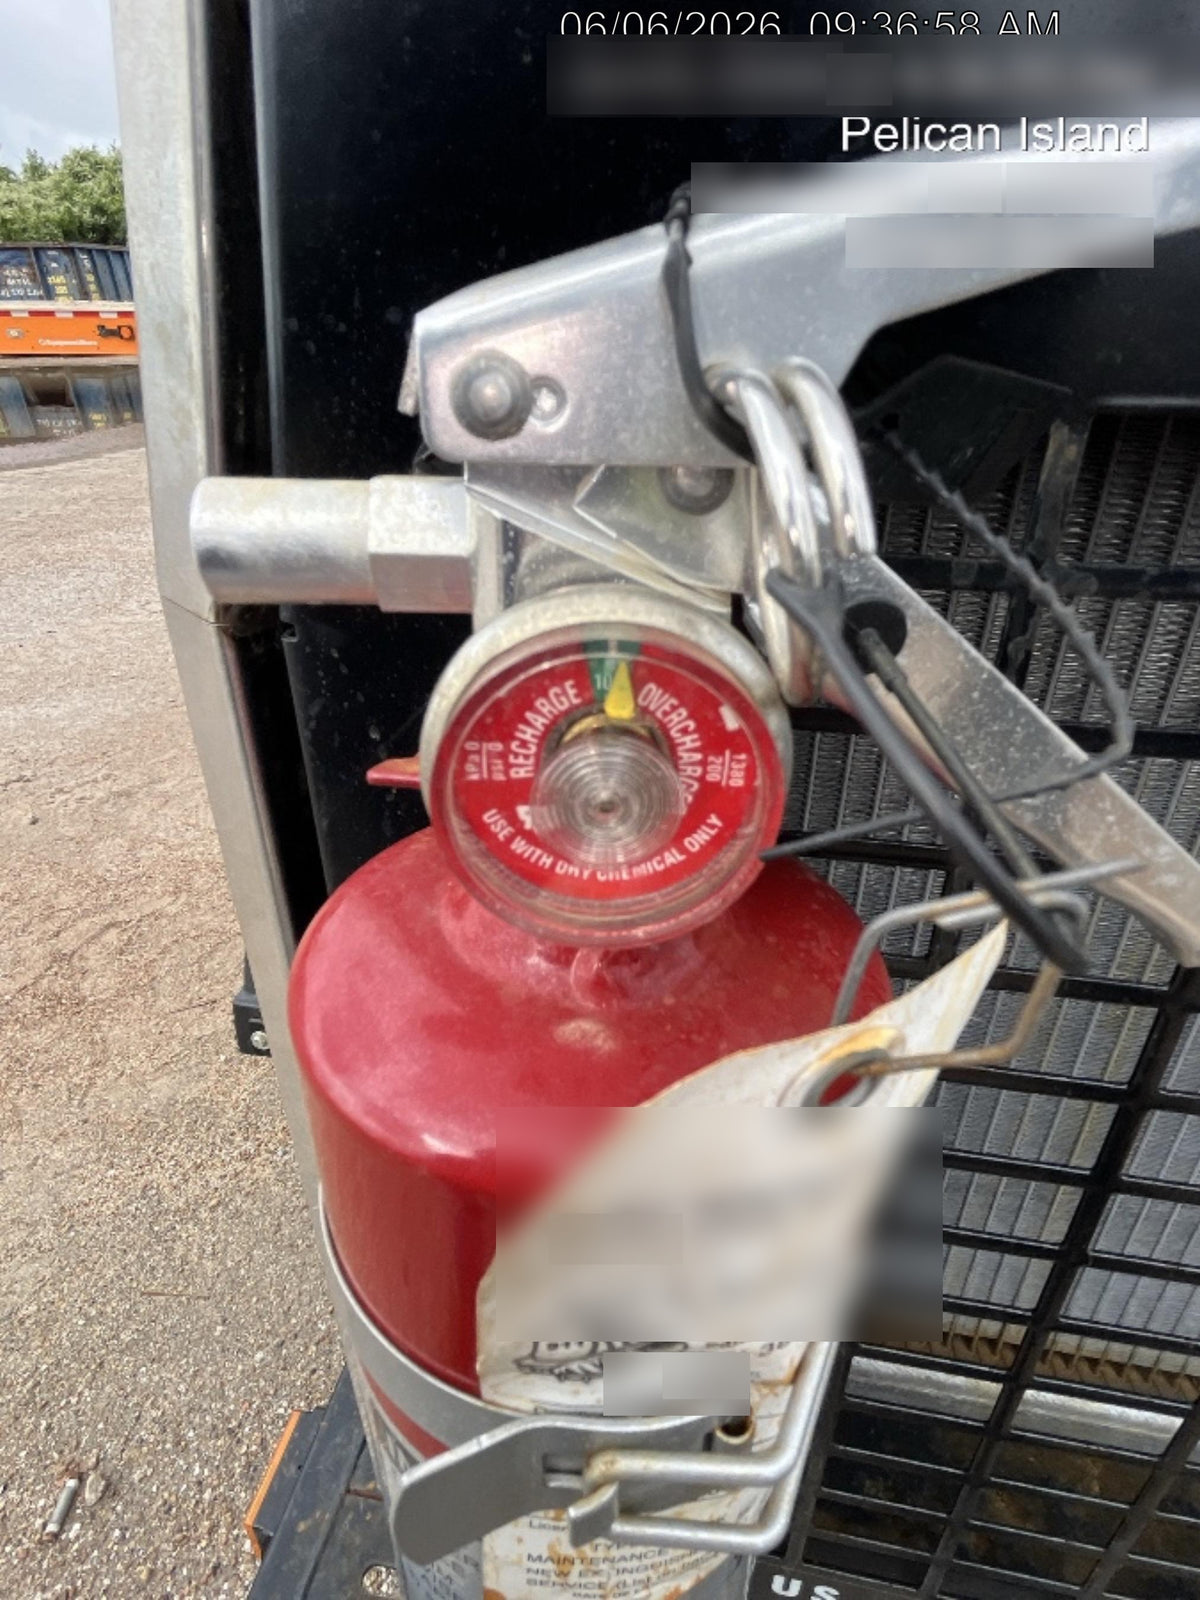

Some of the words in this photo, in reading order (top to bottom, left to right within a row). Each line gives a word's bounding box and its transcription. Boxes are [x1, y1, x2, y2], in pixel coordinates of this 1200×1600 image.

[508, 679, 583, 779] RECHARGE
[705, 755, 723, 783] 200
[728, 753, 747, 788] 1380
[481, 807, 516, 842] USE
[509, 834, 553, 870] WITH
[683, 813, 724, 853] ONLY
[527, 1548, 669, 1566] MAINTENANCE
